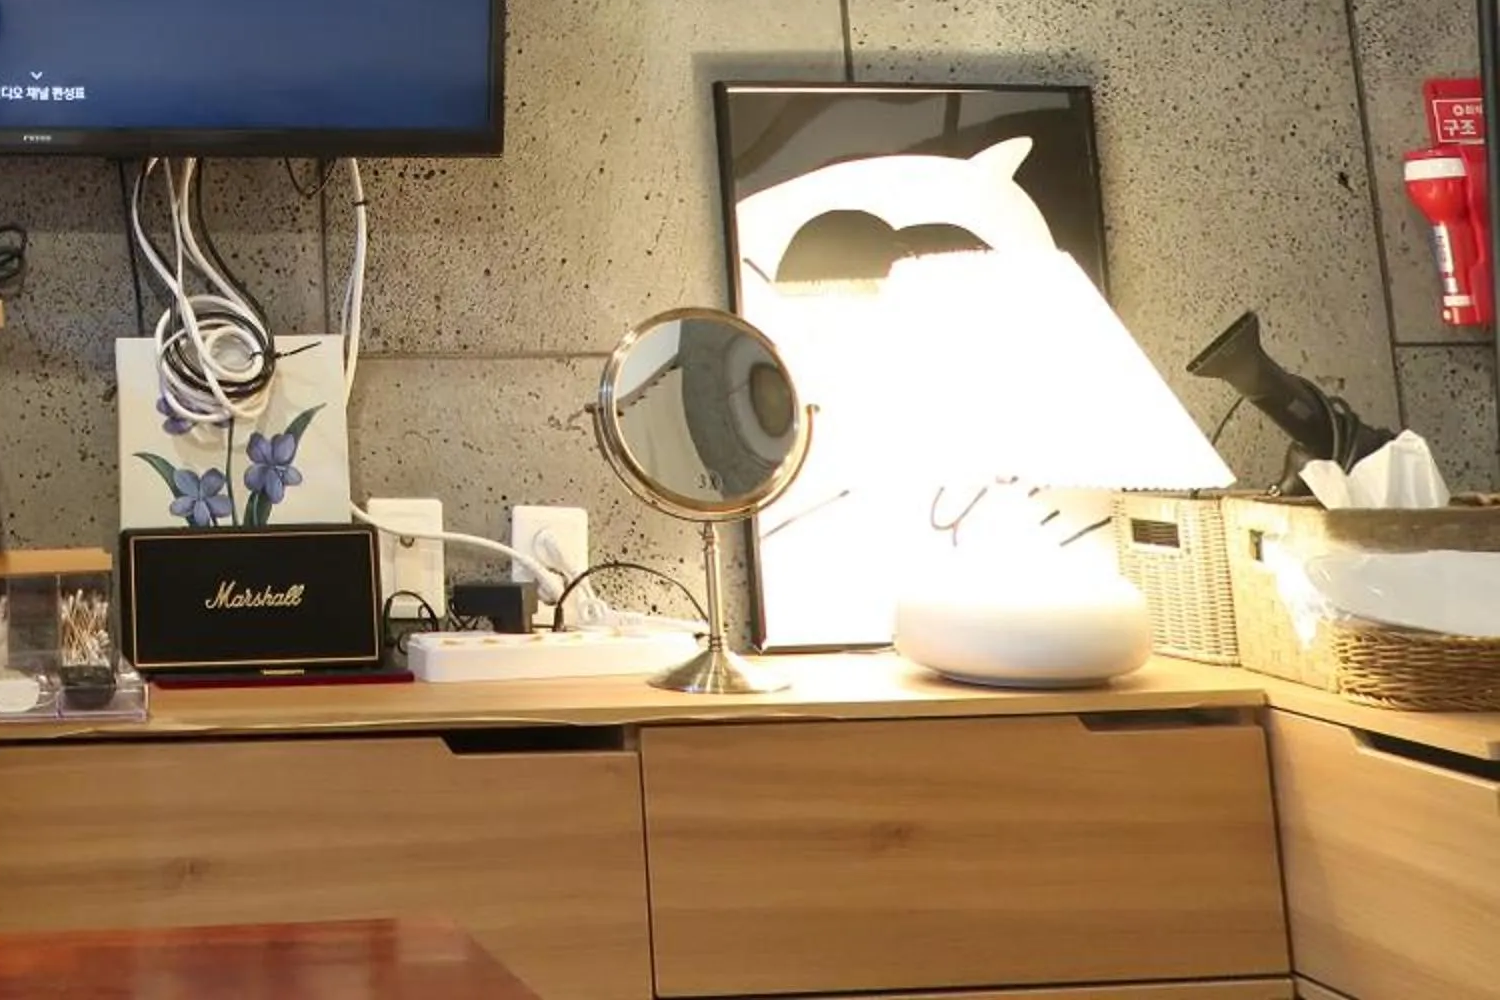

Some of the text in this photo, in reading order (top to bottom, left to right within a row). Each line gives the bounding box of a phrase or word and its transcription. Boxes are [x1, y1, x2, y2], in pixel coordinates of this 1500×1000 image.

[25, 85, 50, 101] 채널
[51, 85, 86, 101] 편성표
[204, 579, 305, 609] Marshall
